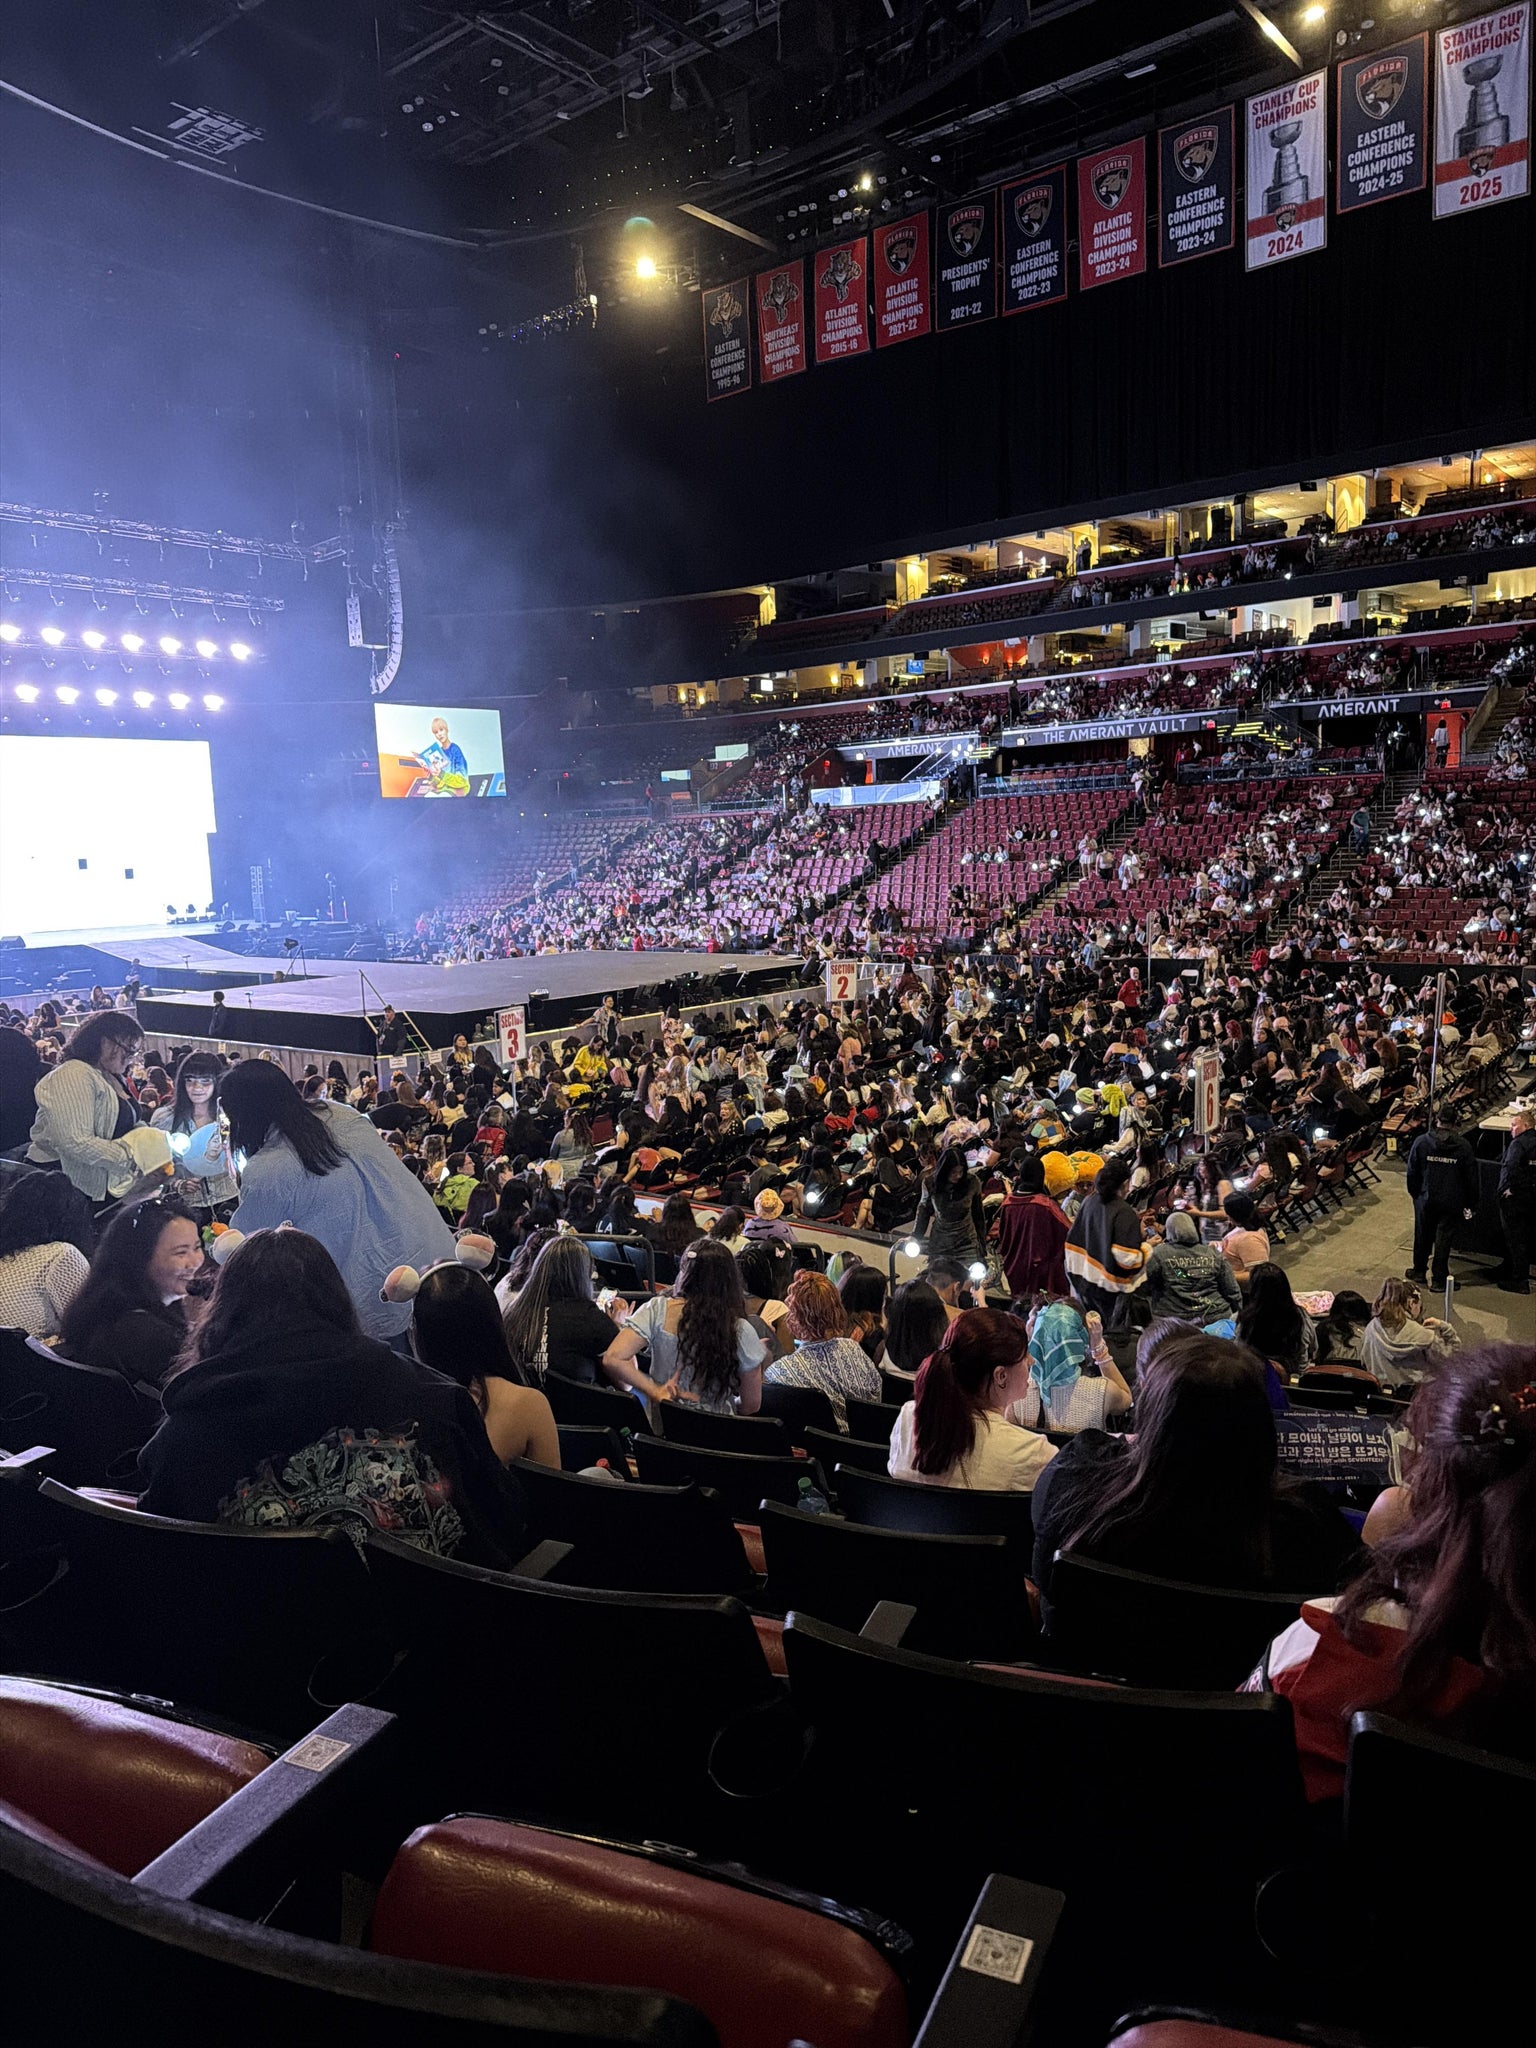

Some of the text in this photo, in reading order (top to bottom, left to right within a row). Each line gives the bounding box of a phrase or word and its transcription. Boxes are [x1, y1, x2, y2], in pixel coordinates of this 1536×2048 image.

[1443, 10, 1524, 50] STANLEY CUP
[1446, 28, 1520, 65] CHAMPIONS
[1252, 79, 1320, 116] STANLEY CUP
[1255, 96, 1317, 130] CHAMPIONS
[1357, 120, 1406, 148] EASTERN
[1347, 132, 1416, 167] CONFERENCE
[1349, 150, 1413, 183] CHAMPIONS
[1358, 170, 1404, 196] 2024-25
[1460, 176, 1502, 205] 2025
[1176, 184, 1216, 209] EASTERN
[1168, 197, 1225, 226] CONFERENCE
[1093, 212, 1132, 235] ATLANTIC
[1169, 213, 1223, 240] CHAMPIONS
[1094, 226, 1131, 249] DIVISION
[1177, 230, 1215, 253] 2023-24
[1268, 230, 1303, 258] 2024
[1016, 239, 1051, 260] EASTERN
[1088, 239, 1137, 265] CHAMPIONS
[942, 258, 990, 281] PRESIDENTS'
[1010, 251, 1059, 276] CONFERENCE
[1095, 256, 1130, 277] 2023-24
[885, 277, 918, 298] ATLANTIC
[951, 274, 980, 293] TROPHY
[1011, 265, 1058, 289] CHAMPIONS
[886, 291, 918, 310] DIVISION
[1018, 281, 1050, 300] 2022-23
[825, 303, 858, 321] ATLANTIC
[882, 304, 923, 326] CHAMPIONS
[950, 302, 982, 320] 2021-22
[764, 322, 799, 342] SOUTHEAST
[822, 325, 862, 343] CHAMPIONS
[826, 315, 858, 332] DIVISION
[888, 321, 917, 337] 2021-22
[714, 338, 740, 356] EASTERN
[764, 345, 800, 365] CHAMPIONS
[768, 335, 795, 352] DIVISION
[830, 340, 858, 354] 2015-16
[710, 349, 745, 369] CONFERENCE
[712, 361, 745, 380] CHAMPIONS
[1318, 699, 1400, 718] AMERANT
[1043, 718, 1187, 743] THE AMERANT VAULT
[887, 742, 941, 756] AMERANT
[831, 964, 854, 974] SECTION
[837, 976, 848, 999] 2
[507, 1029, 518, 1058] 3
[1207, 1083, 1213, 1127] 6
[1426, 1156, 1458, 1164] SECURITY
